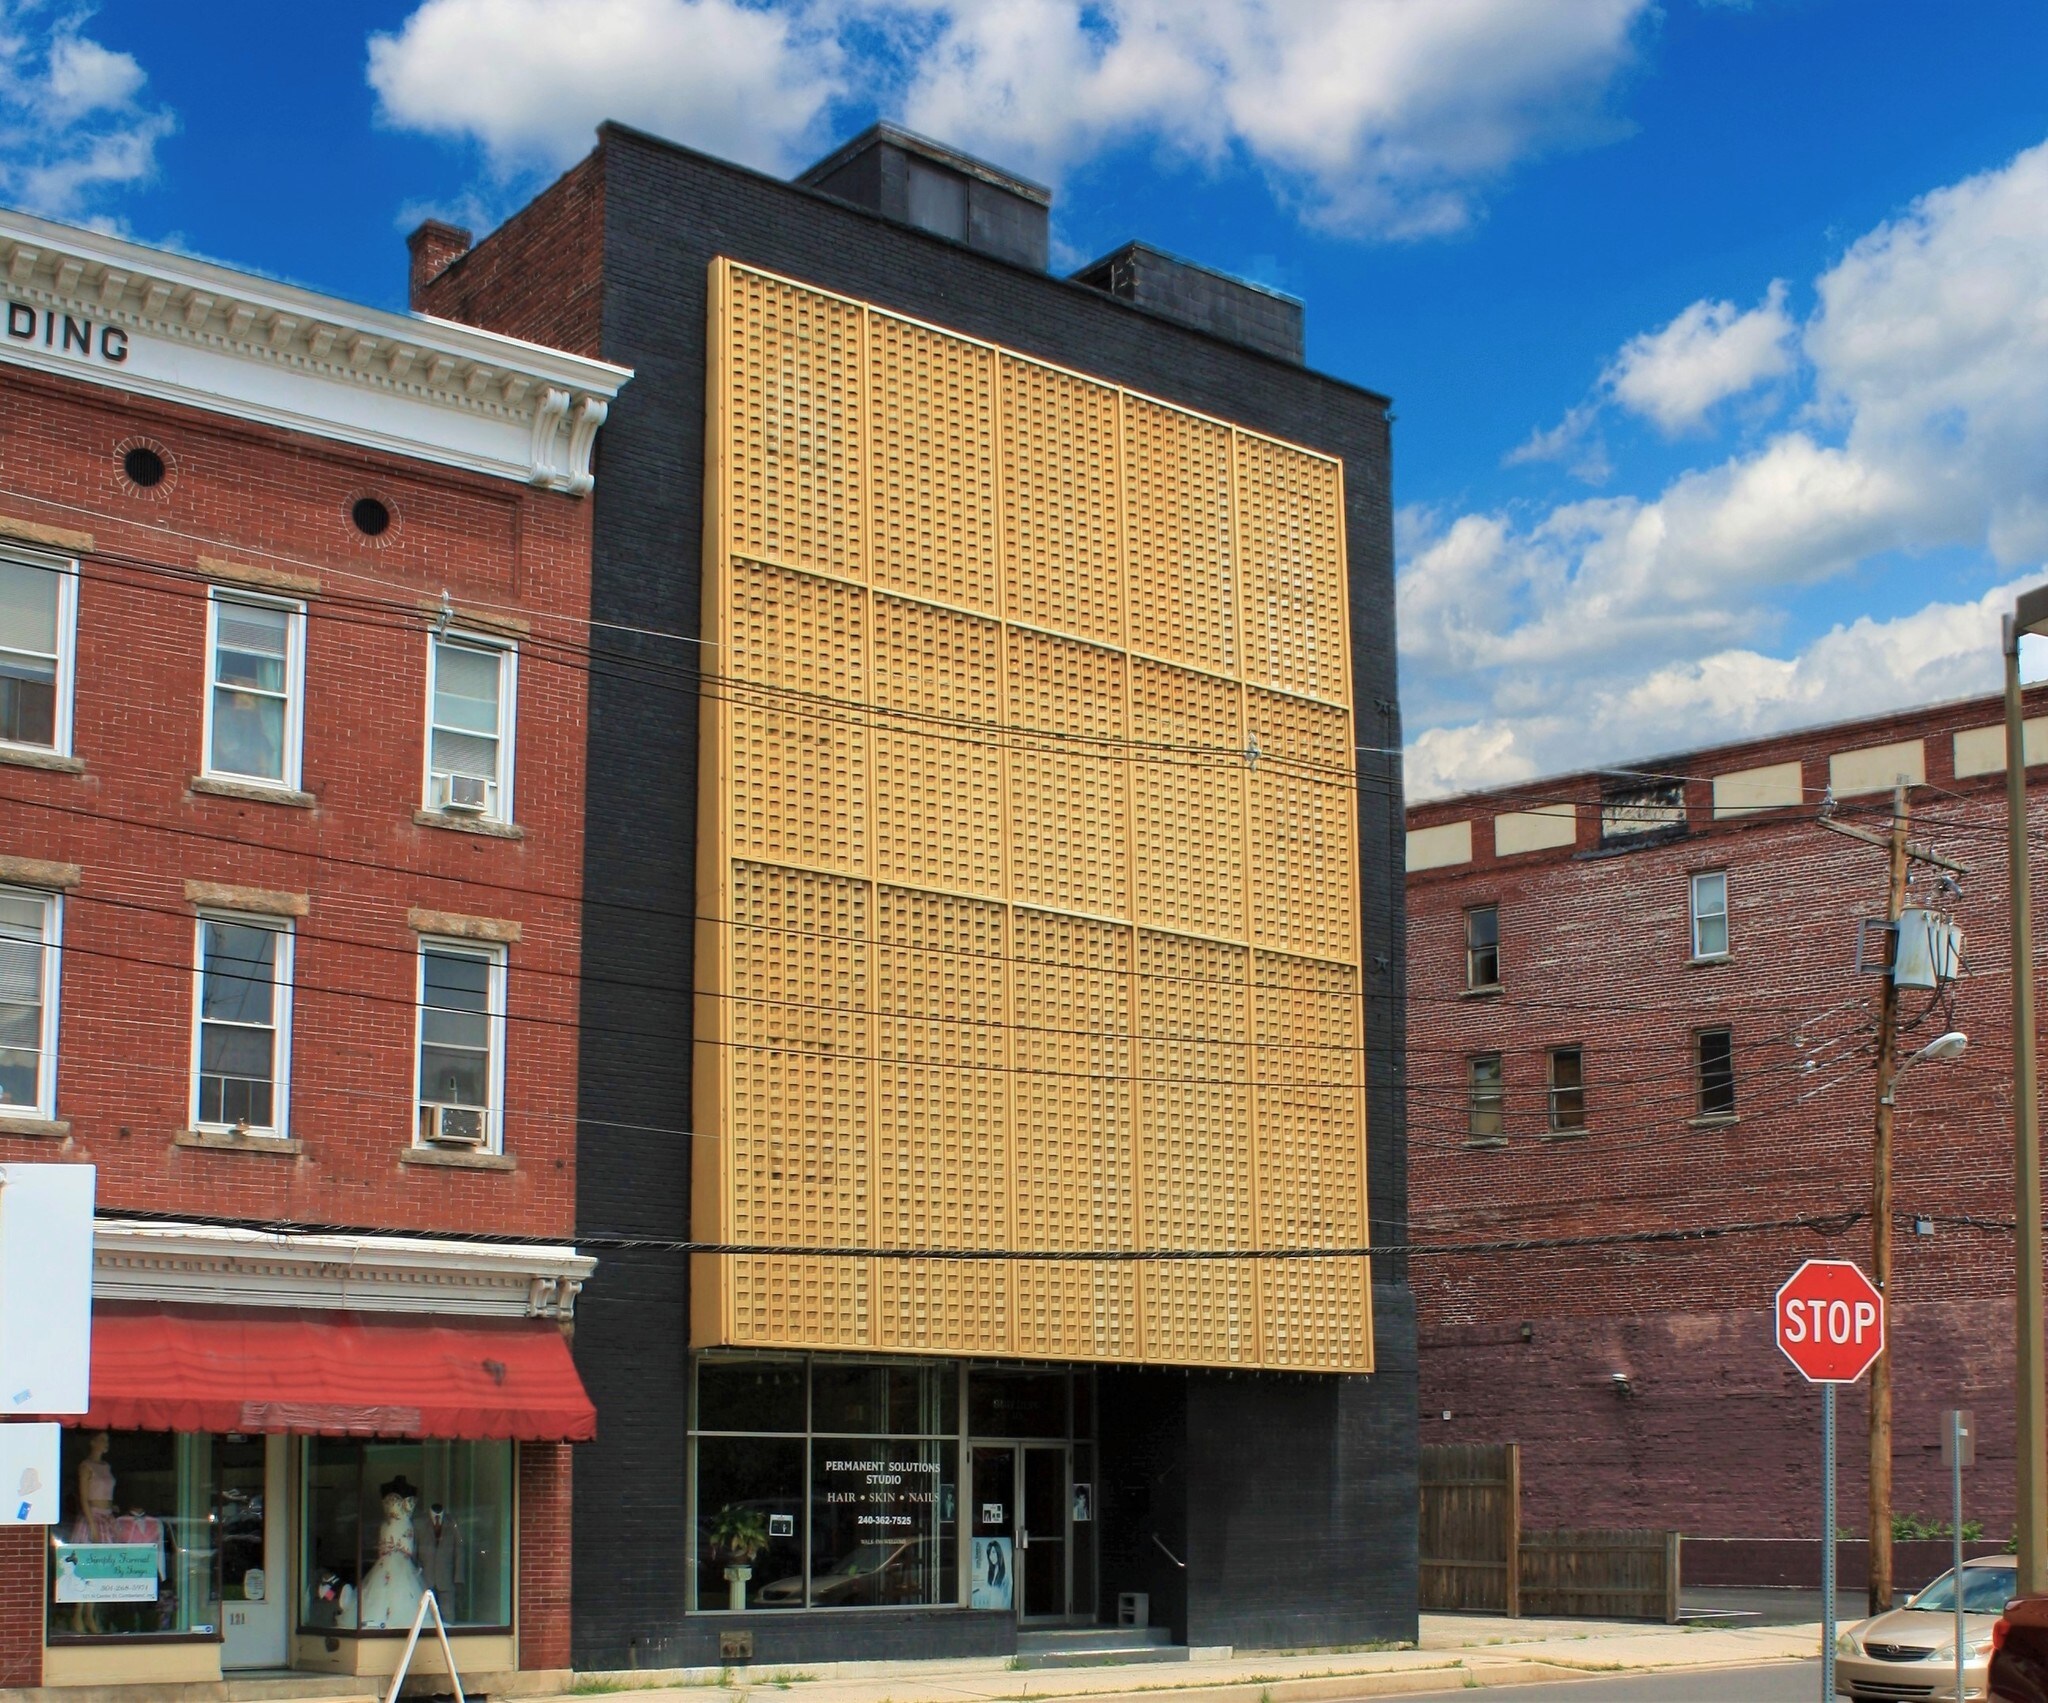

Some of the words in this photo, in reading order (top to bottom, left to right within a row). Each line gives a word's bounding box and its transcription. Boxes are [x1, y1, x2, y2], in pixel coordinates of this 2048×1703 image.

[8, 302, 128, 362] DING
[1785, 1299, 1876, 1344] STOP
[826, 1461, 885, 1471] PERMANENT
[888, 1462, 941, 1473] SOLUTIONS
[866, 1474, 902, 1485] STUDIO
[827, 1492, 857, 1503] HAIR
[869, 1492, 896, 1503] SKIN
[908, 1492, 940, 1503] NAILS
[858, 1515, 912, 1525] 240-362-7525
[86, 1552, 116, 1568] Simply
